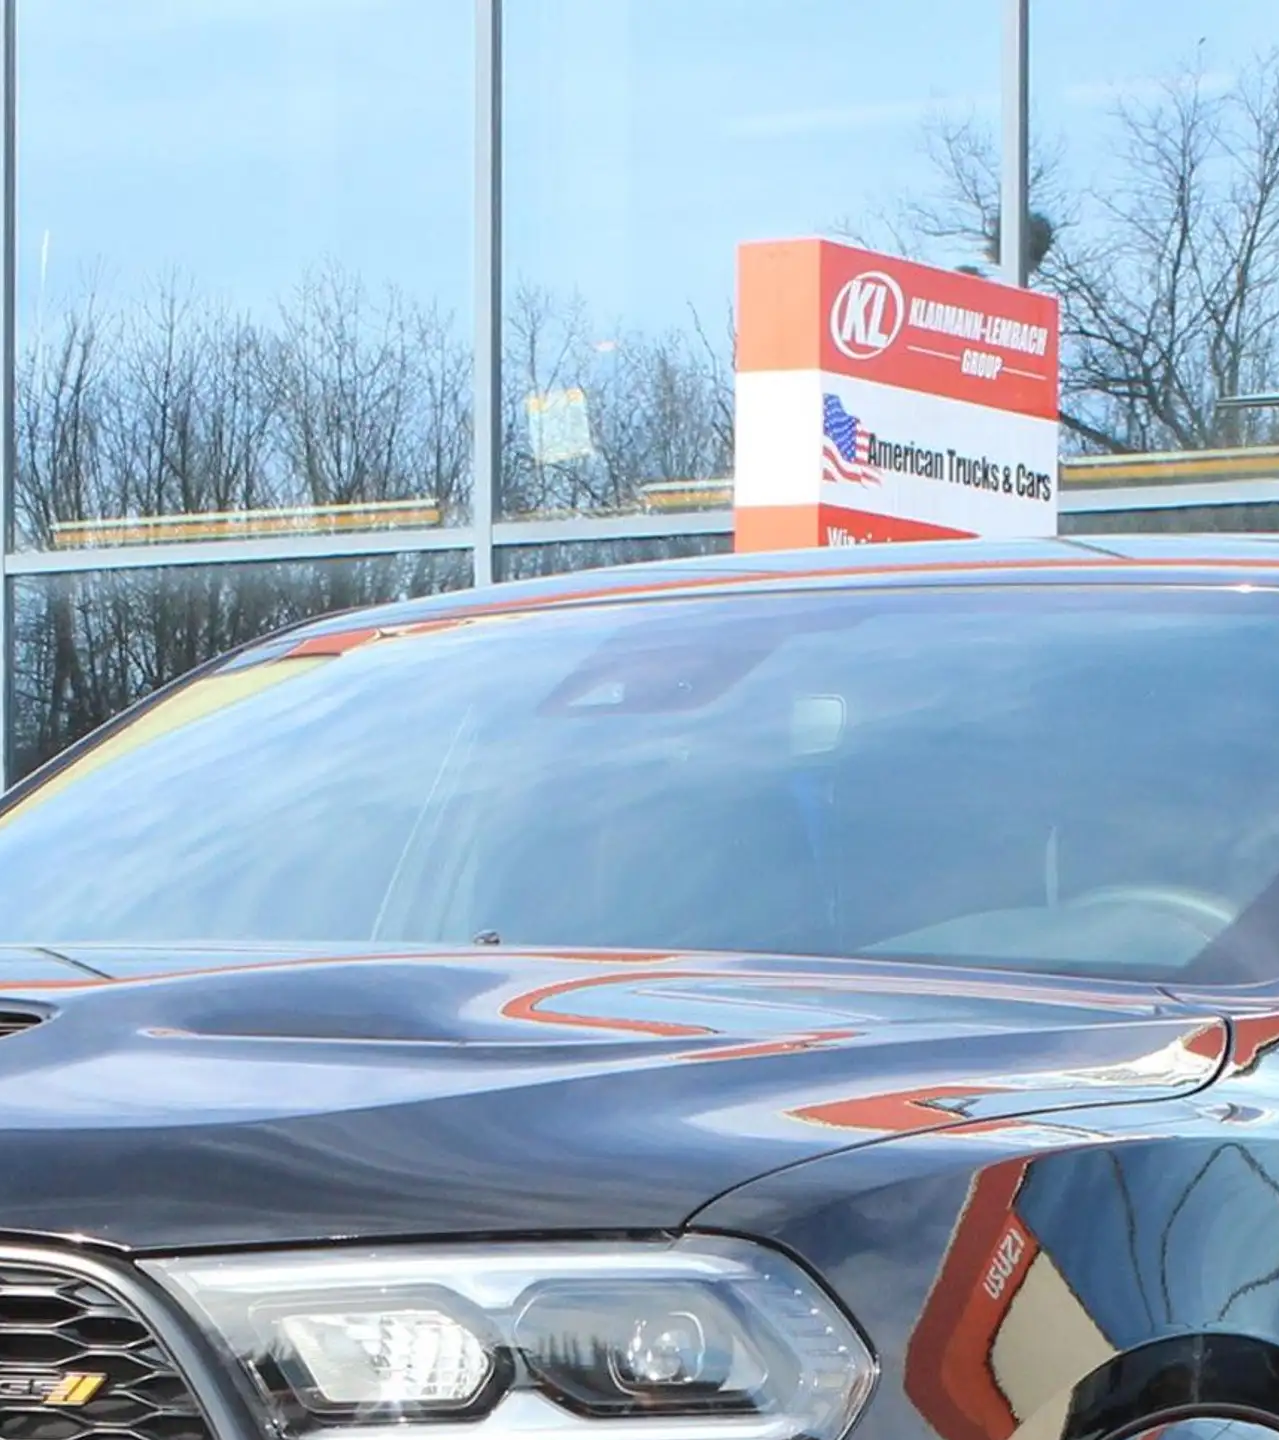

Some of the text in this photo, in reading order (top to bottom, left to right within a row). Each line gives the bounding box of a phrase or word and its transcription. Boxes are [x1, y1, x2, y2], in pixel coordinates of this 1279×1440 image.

[841, 279, 889, 348] KL
[908, 297, 1048, 356] KLARMANN-LEMBACH
[961, 348, 1003, 380] GROUP
[867, 433, 1052, 501] American Trucks & Cars
